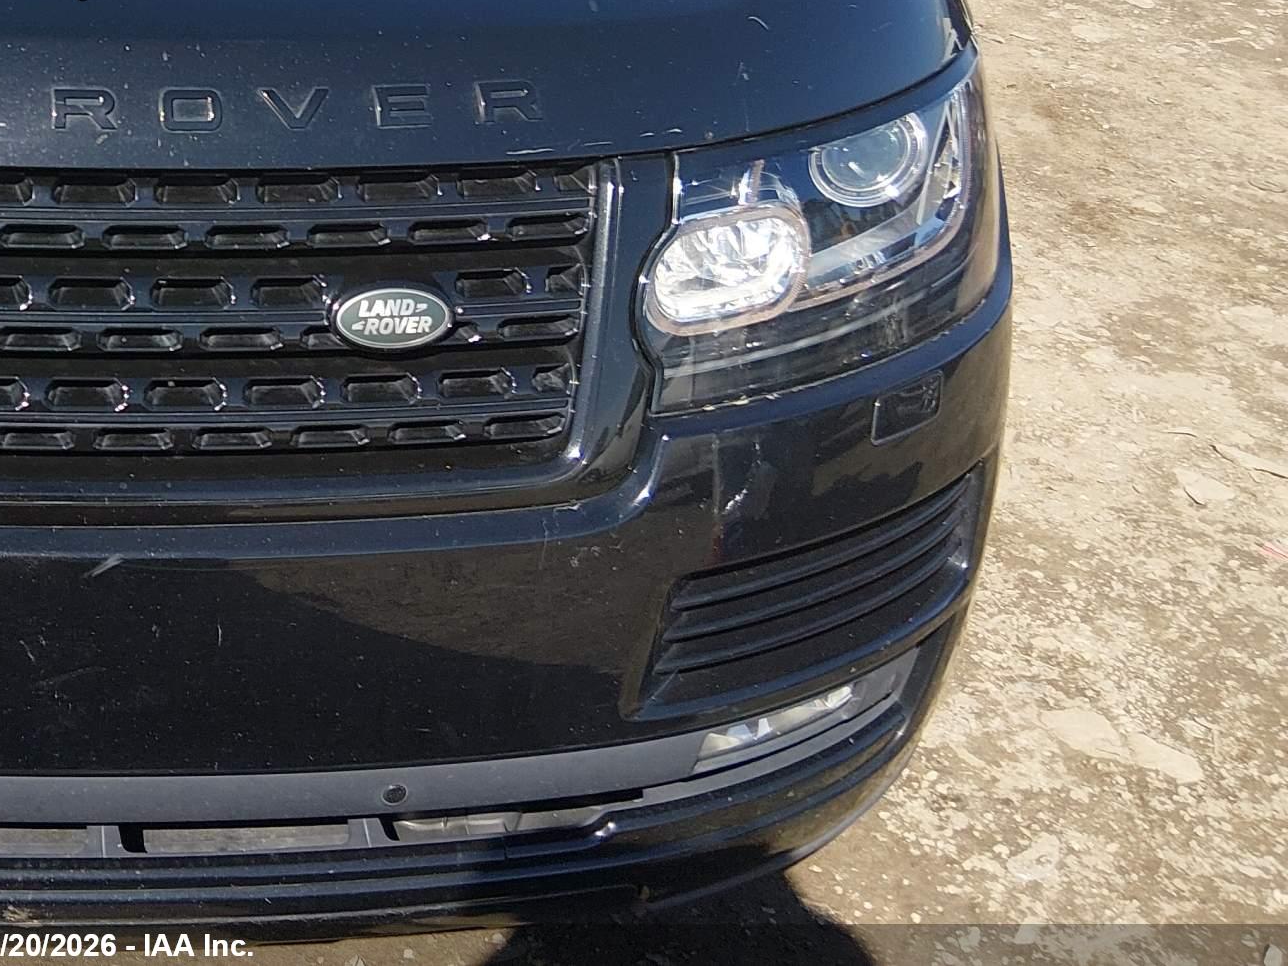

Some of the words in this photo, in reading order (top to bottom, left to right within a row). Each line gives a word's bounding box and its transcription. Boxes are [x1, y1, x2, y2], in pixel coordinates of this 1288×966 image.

[51, 79, 544, 131] ROVER
[358, 298, 416, 318] LAND
[363, 315, 433, 335] ROVER
